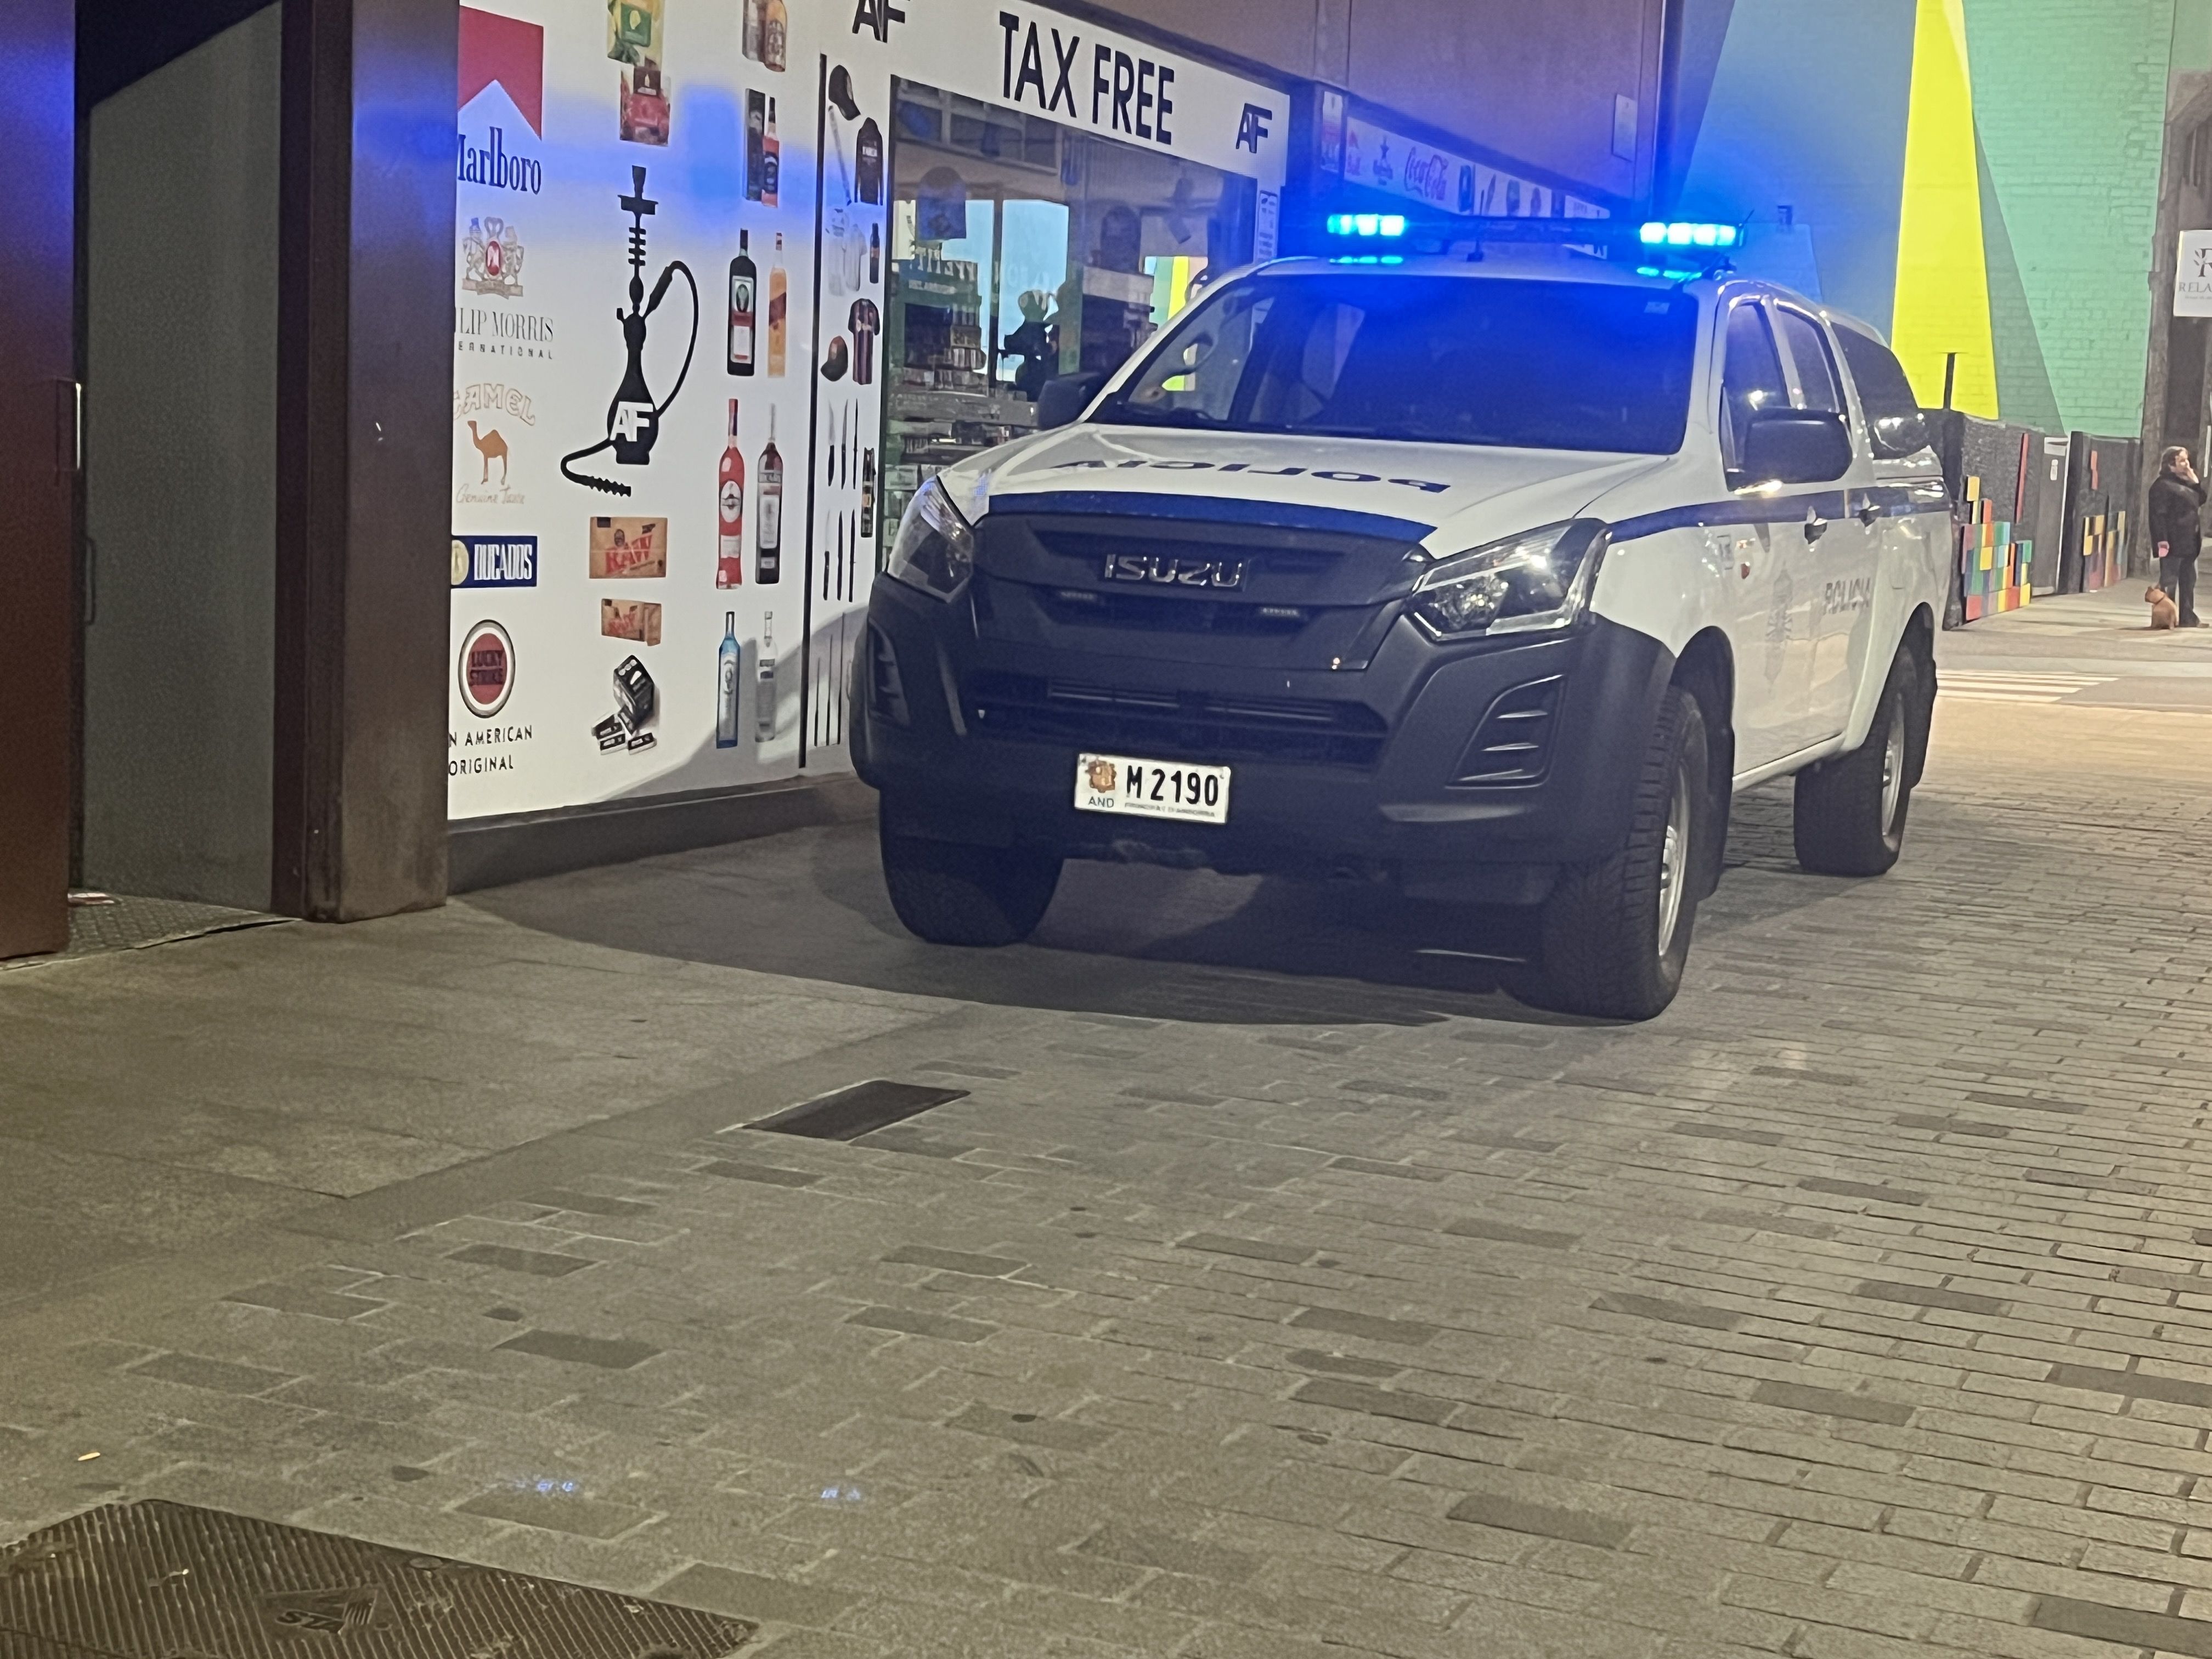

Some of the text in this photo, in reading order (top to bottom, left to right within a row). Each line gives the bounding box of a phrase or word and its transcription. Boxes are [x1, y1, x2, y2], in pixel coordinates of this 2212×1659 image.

[1000, 10, 1174, 145] TAX FREE
[1235, 103, 1272, 154] AF
[492, 311, 554, 342] MORRIS
[610, 401, 653, 442] AF
[474, 544, 532, 580] DUCADOS
[1104, 554, 1242, 587] ISUZU
[465, 725, 532, 746] AMERICAN
[448, 754, 514, 776] ORIGINAL
[1088, 796, 1114, 808] AND
[1150, 769, 1218, 806] 2190
